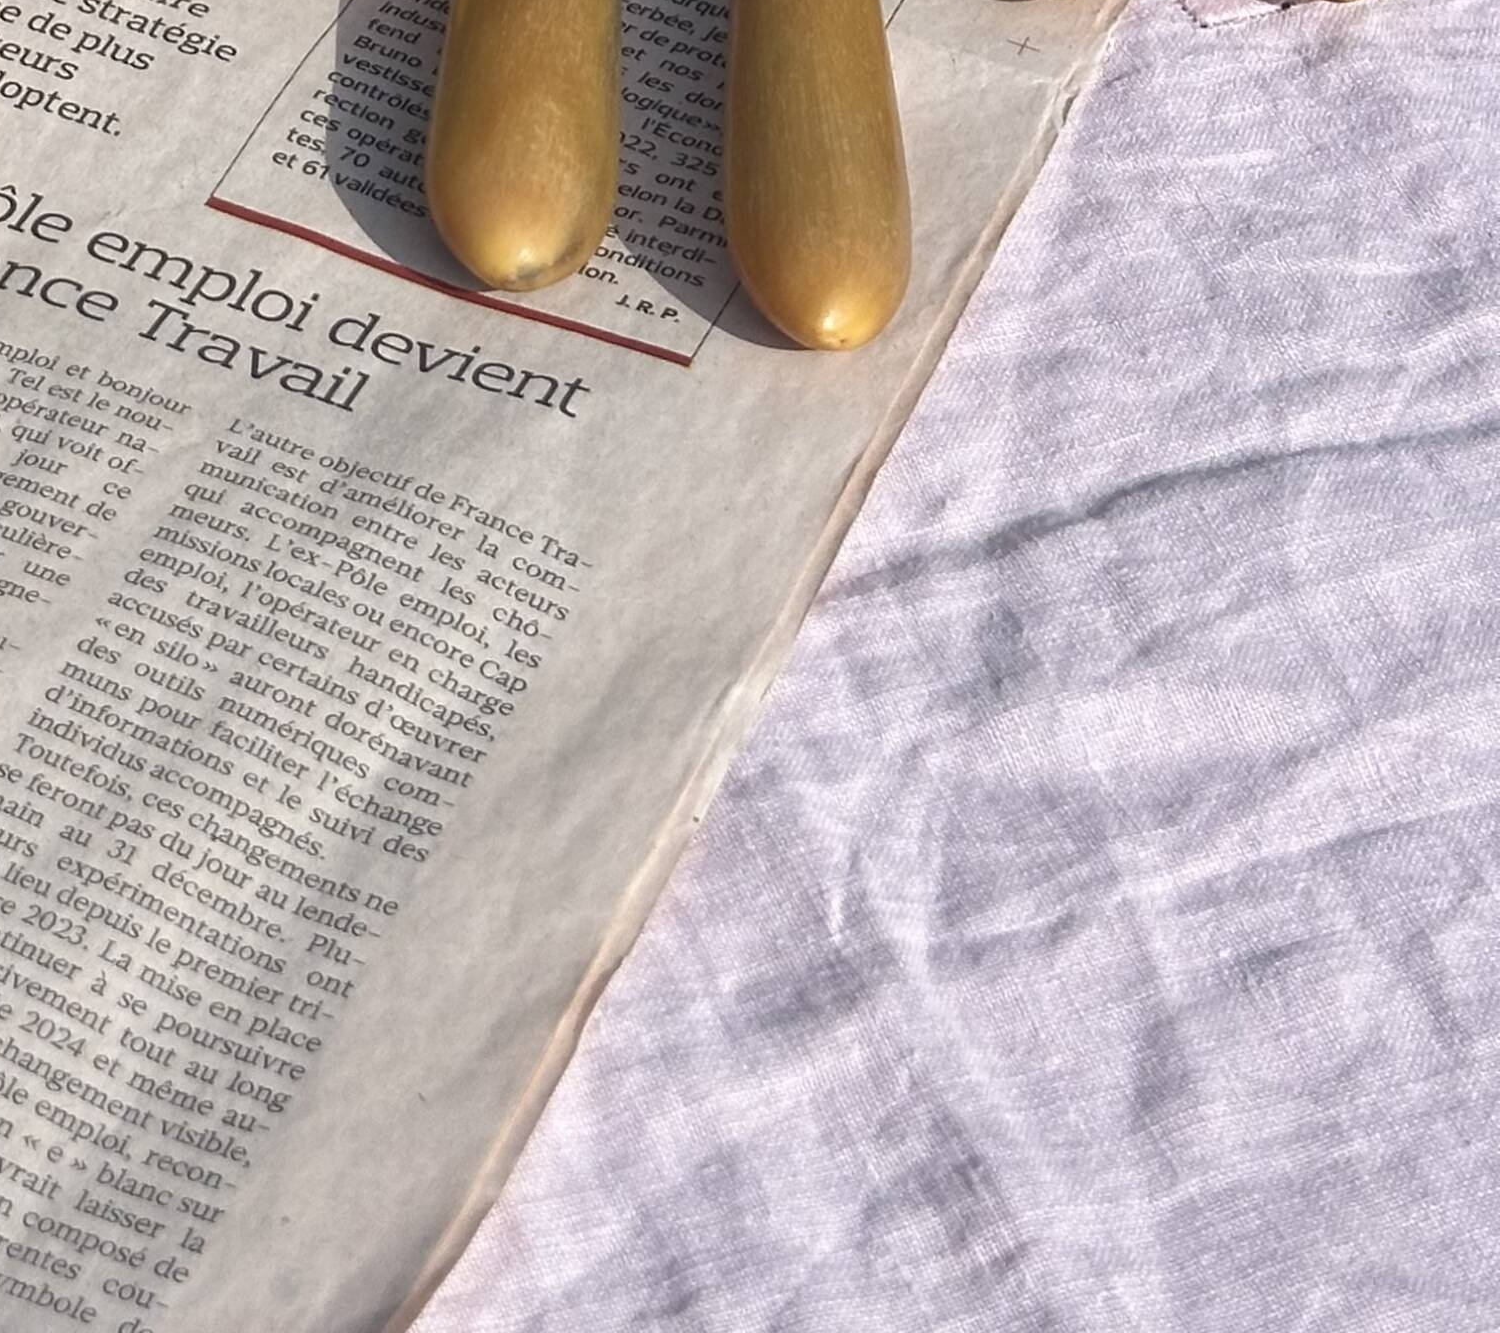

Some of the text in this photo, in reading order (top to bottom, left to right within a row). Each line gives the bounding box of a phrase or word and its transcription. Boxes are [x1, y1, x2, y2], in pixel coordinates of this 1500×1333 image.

[27, 12, 72, 41] de
[70, 31, 155, 71] plus
[352, 34, 423, 68] Bruno
[367, 18, 422, 45] fend
[620, 46, 705, 82] et nos
[271, 151, 298, 170] et
[334, 172, 429, 218] validées
[654, 173, 697, 193] ont
[670, 152, 720, 177] 325
[87, 220, 327, 340] emploi
[326, 298, 592, 419] devient
[635, 299, 655, 316] R.
[659, 306, 680, 323] P.
[139, 303, 369, 414] Travail
[7, 367, 46, 392] Tel
[47, 384, 83, 404] est
[86, 391, 111, 411] le
[113, 405, 173, 431] nou-
[65, 364, 91, 380] et
[96, 369, 192, 415] bonjour
[226, 418, 593, 568] L'autre objectif de France Tra-
[20, 904, 88, 951] 2023.
[97, 939, 133, 973] La
[137, 964, 202, 1008] mise
[208, 1001, 243, 1026] en
[245, 1015, 322, 1053] place
